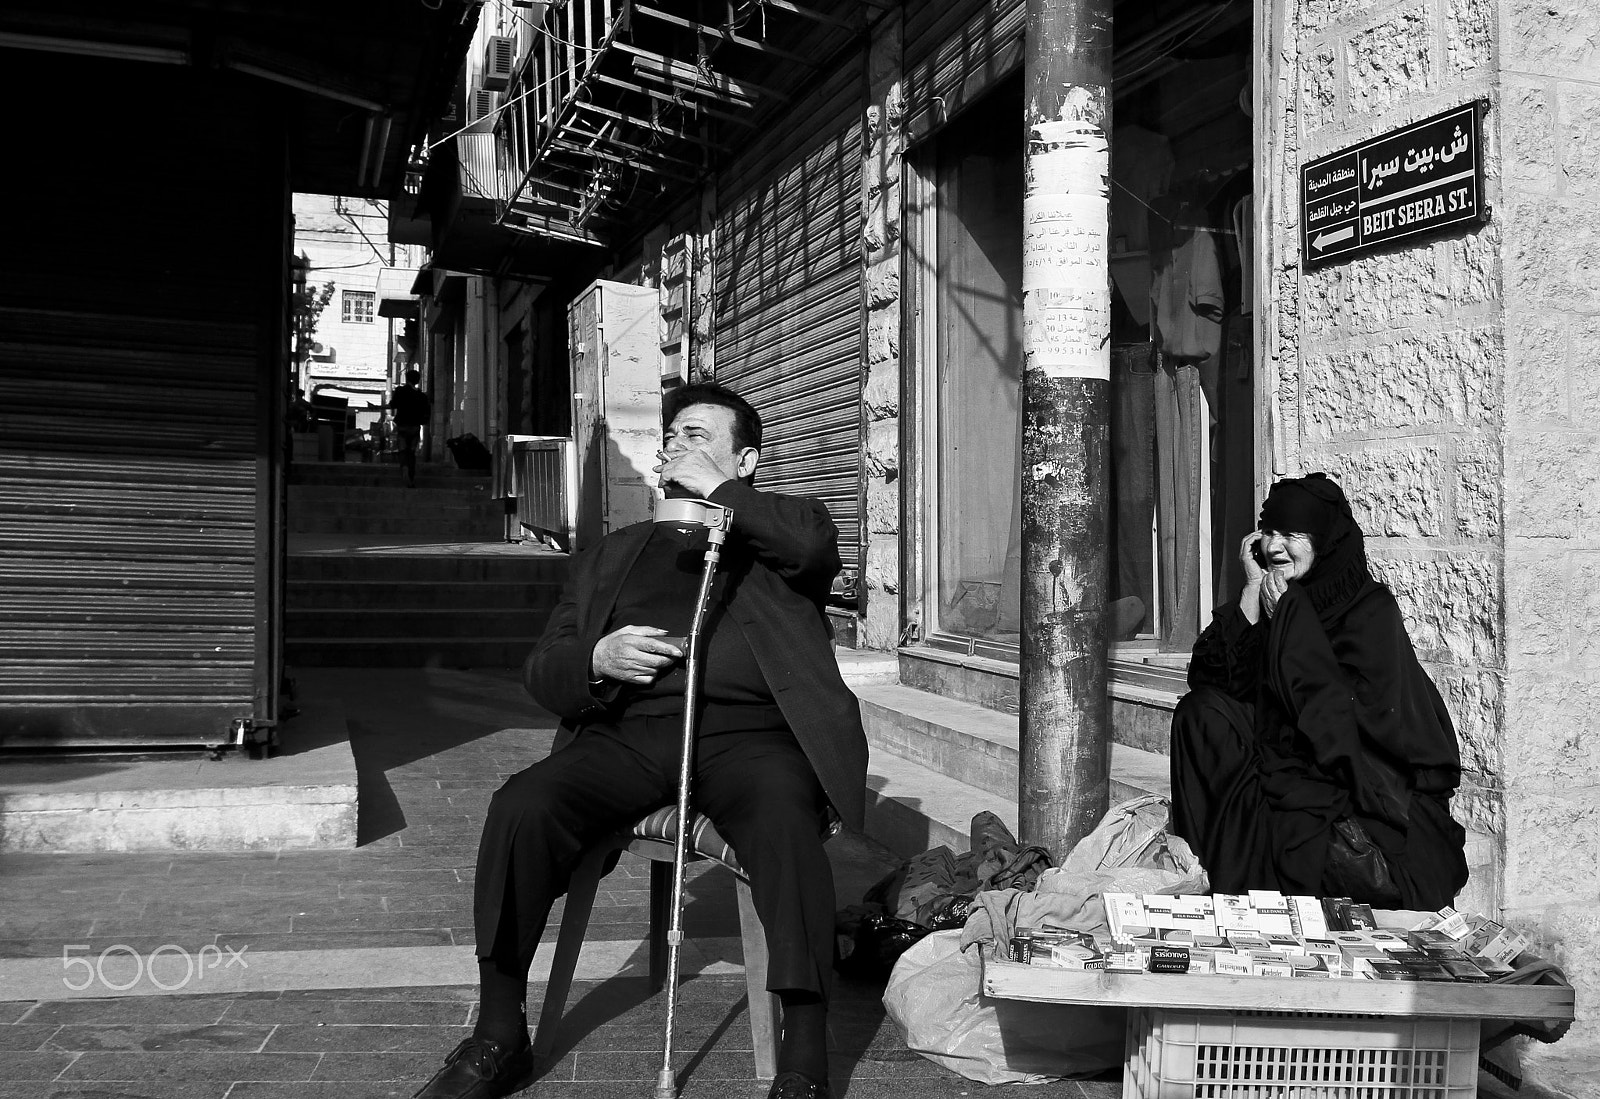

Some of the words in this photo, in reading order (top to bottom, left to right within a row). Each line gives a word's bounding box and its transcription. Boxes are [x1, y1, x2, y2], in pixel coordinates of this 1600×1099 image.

[1333, 168, 1355, 183] منطقة
[1362, 155, 1400, 190] سيرا
[1308, 174, 1332, 192] المدينة
[1309, 207, 1329, 222] القلعة
[1330, 204, 1344, 217] جبل
[1344, 200, 1357, 214] حي
[1363, 212, 1396, 236] BEIT
[1398, 194, 1446, 226] SEERA
[1448, 187, 1473, 213] ST.
[1154, 951, 1189, 959] GAULOISES
